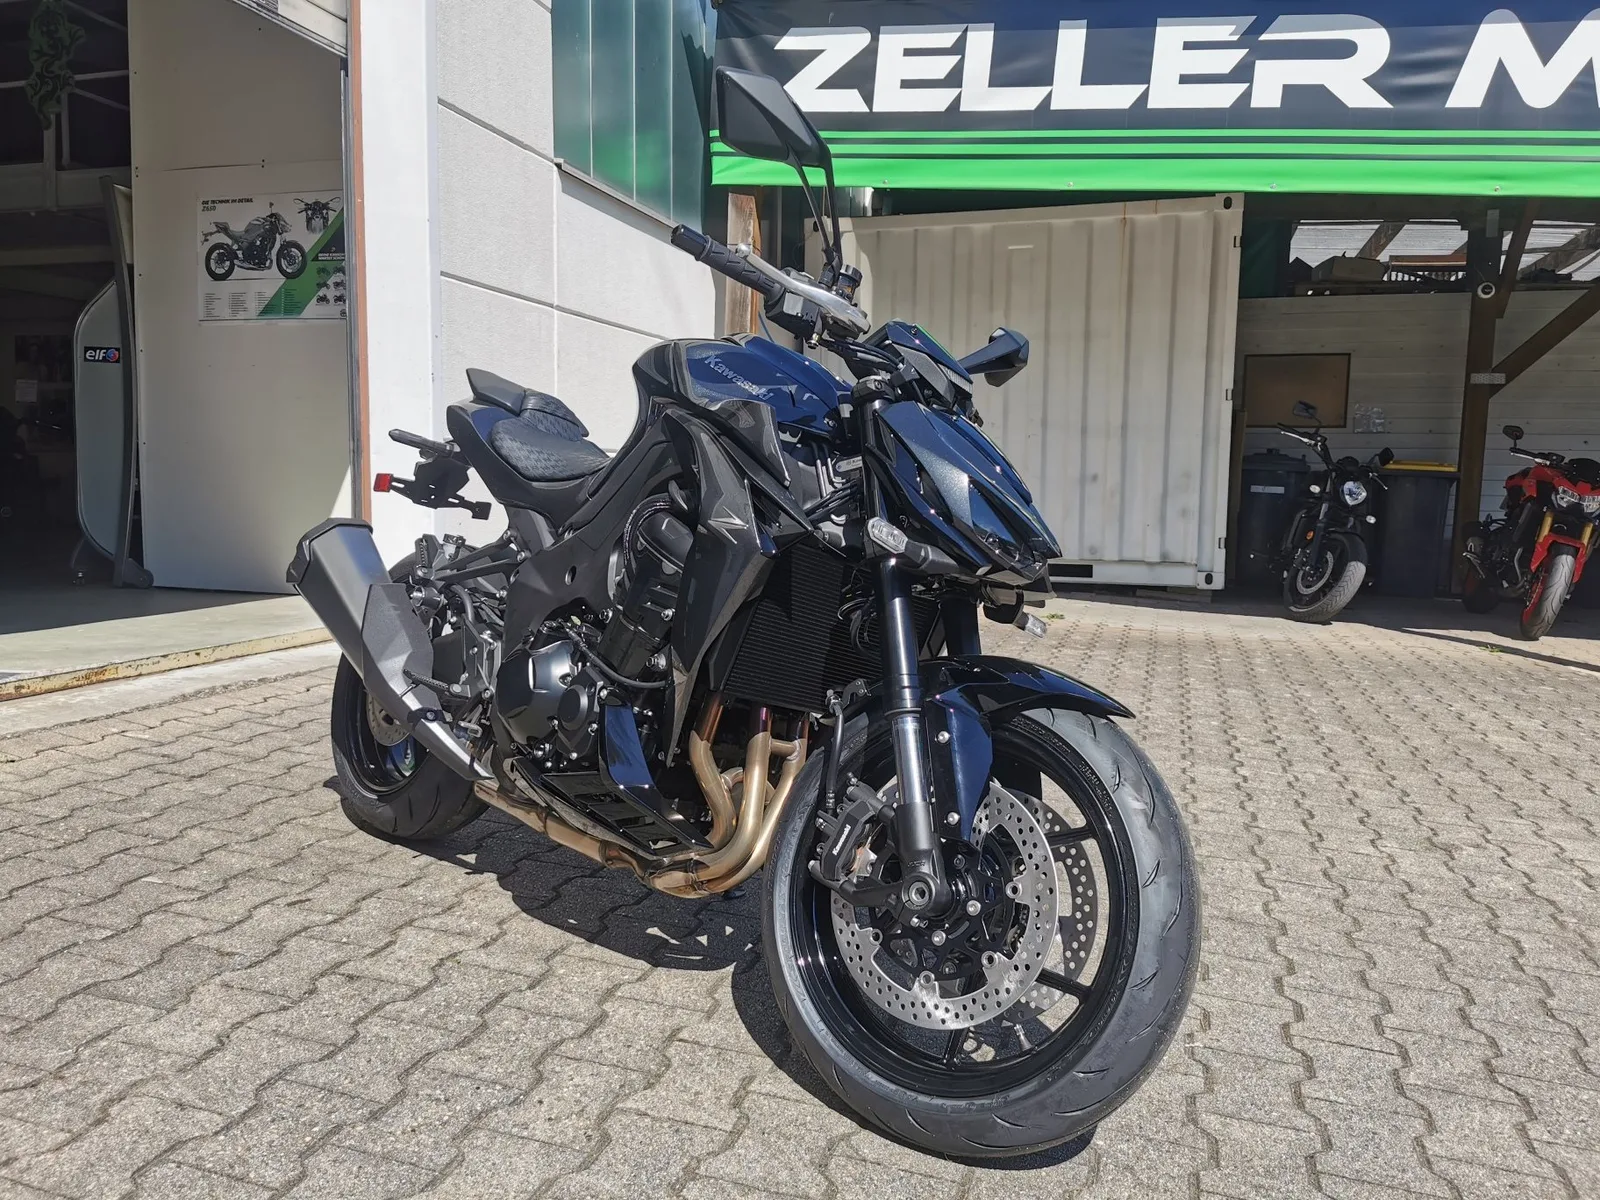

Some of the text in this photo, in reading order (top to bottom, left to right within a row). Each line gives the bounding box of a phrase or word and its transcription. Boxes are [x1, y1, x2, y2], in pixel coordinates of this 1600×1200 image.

[774, 8, 1600, 112] ZELLER M
[85, 349, 107, 360] elf
[704, 354, 774, 400] Kawasaki
[832, 823, 851, 856] Kawasaki
